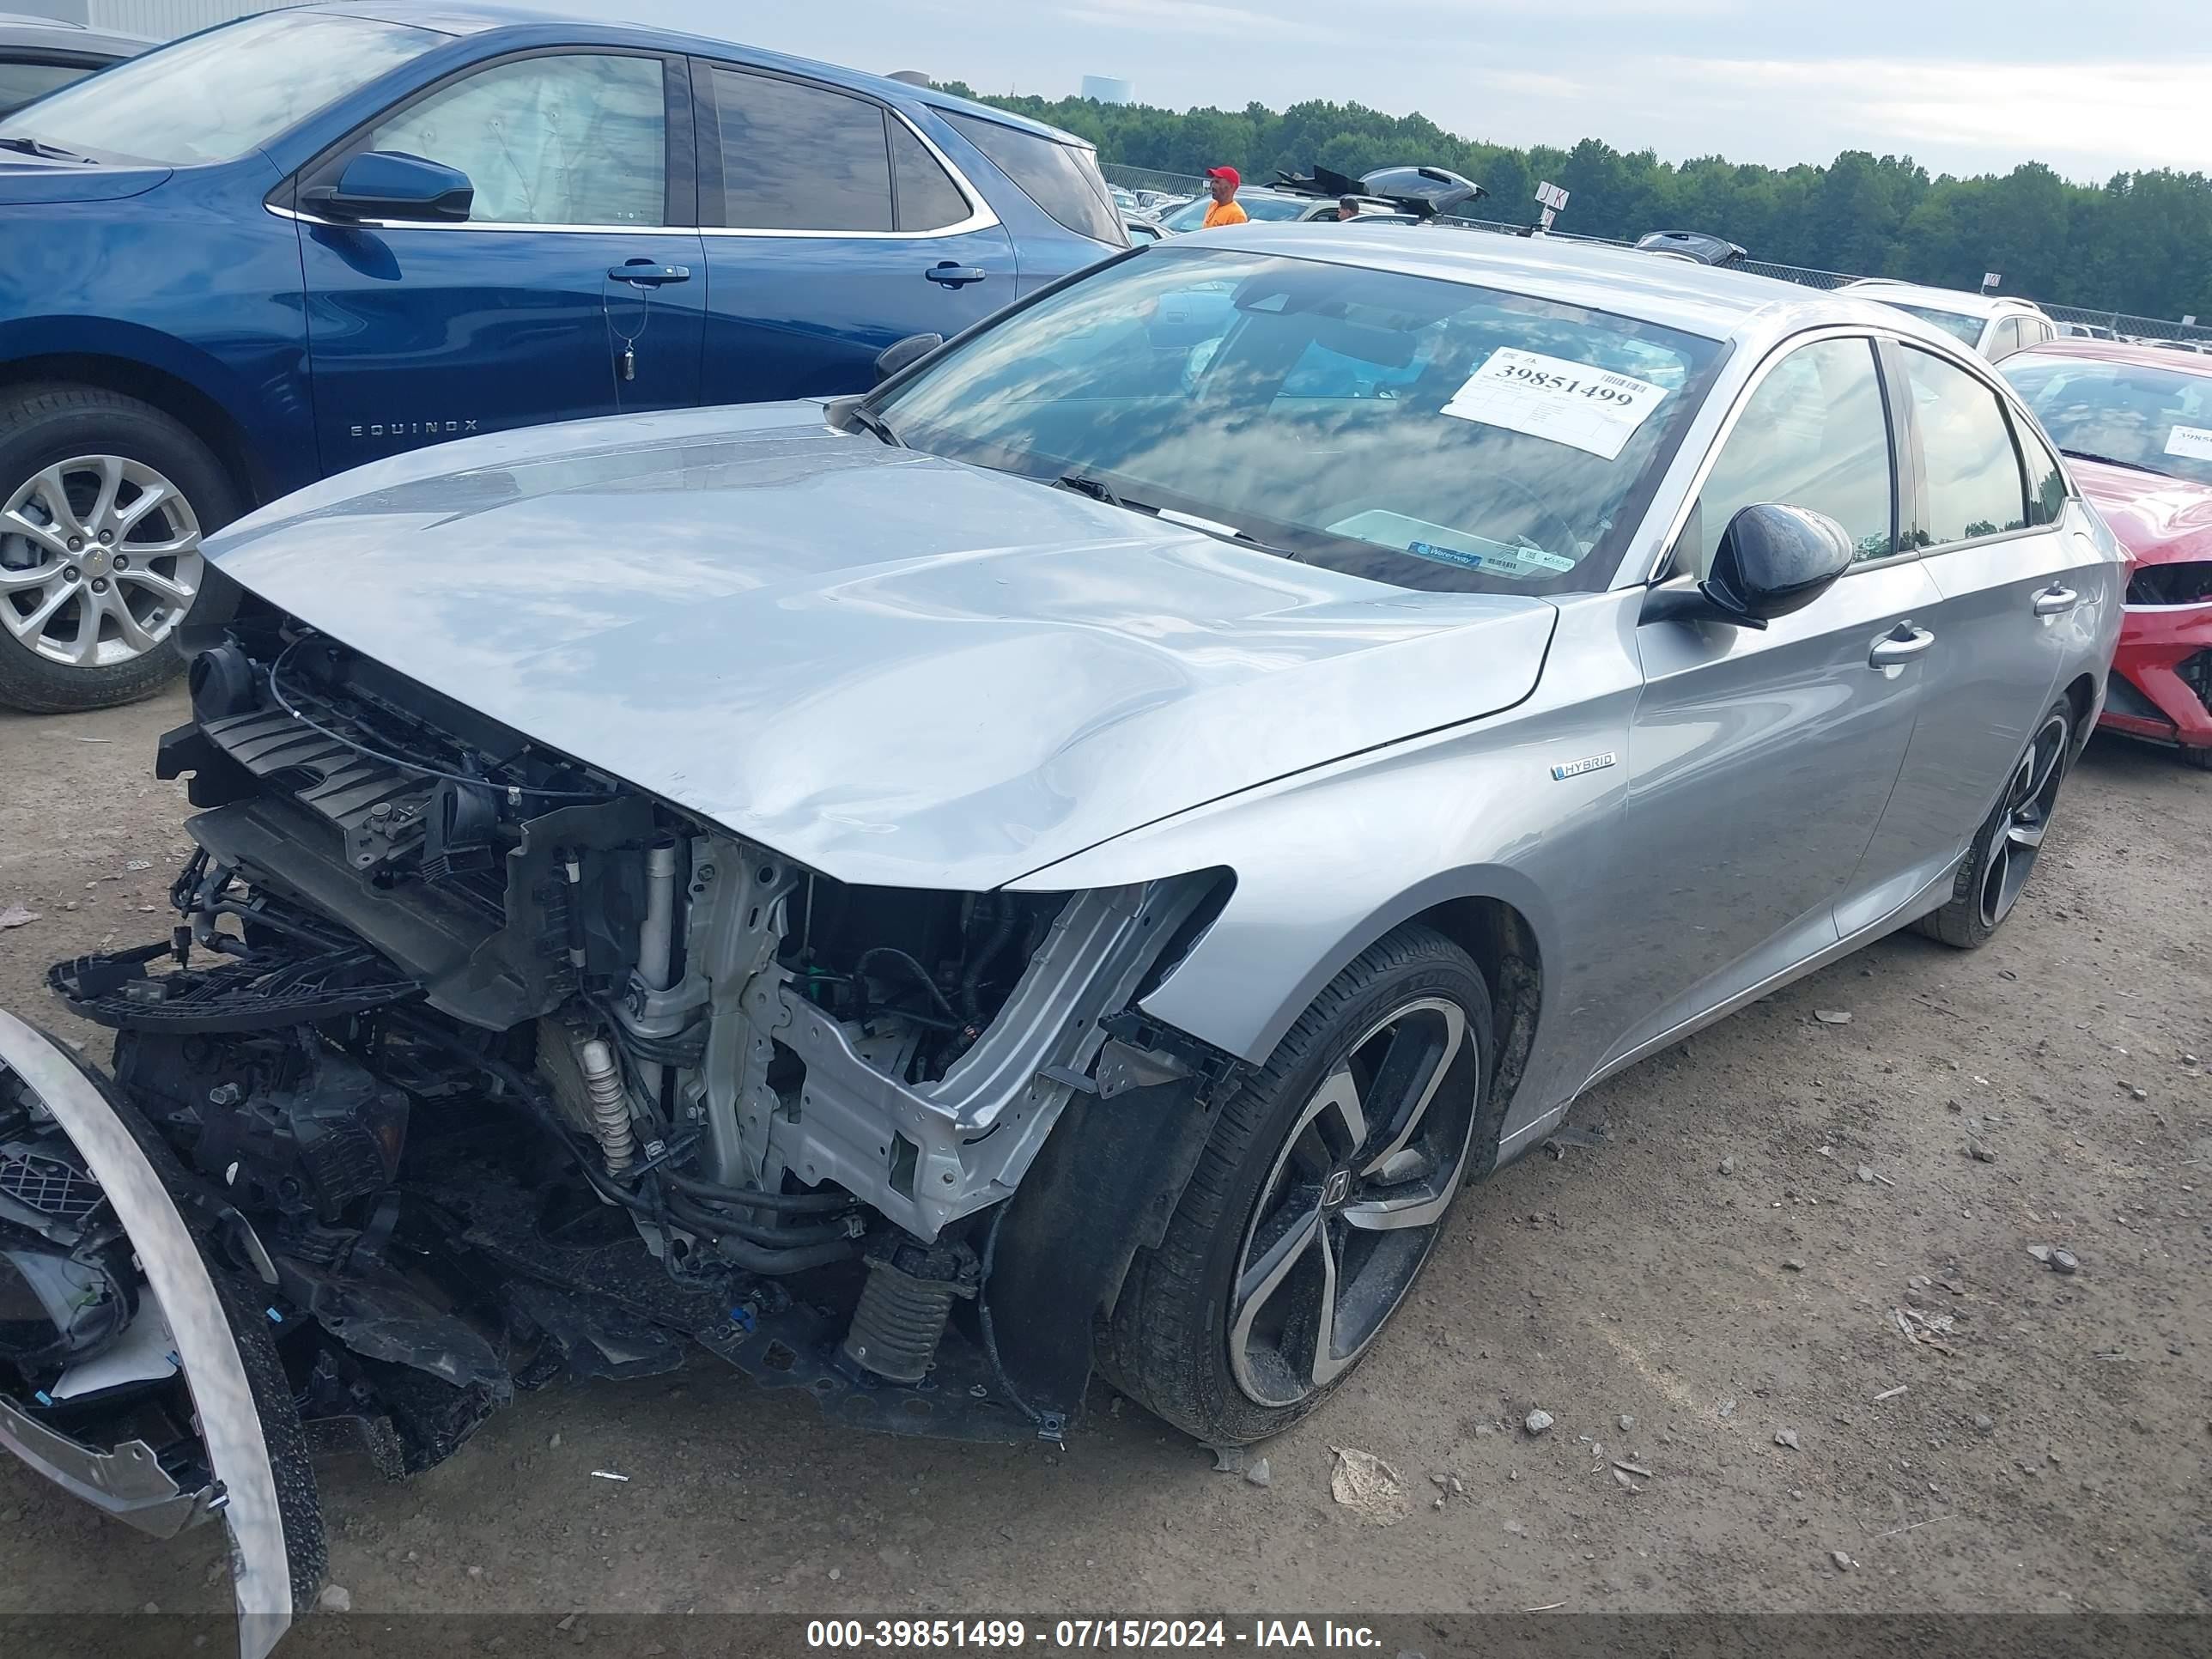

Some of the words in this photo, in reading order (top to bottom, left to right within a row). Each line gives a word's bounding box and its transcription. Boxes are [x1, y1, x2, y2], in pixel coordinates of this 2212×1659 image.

[1553, 189, 1566, 209] K
[1494, 365, 1633, 406] 39851499
[350, 419, 477, 437] EQUINOX
[1429, 547, 1473, 564] Waterway
[1565, 755, 1612, 775] HYBRID
